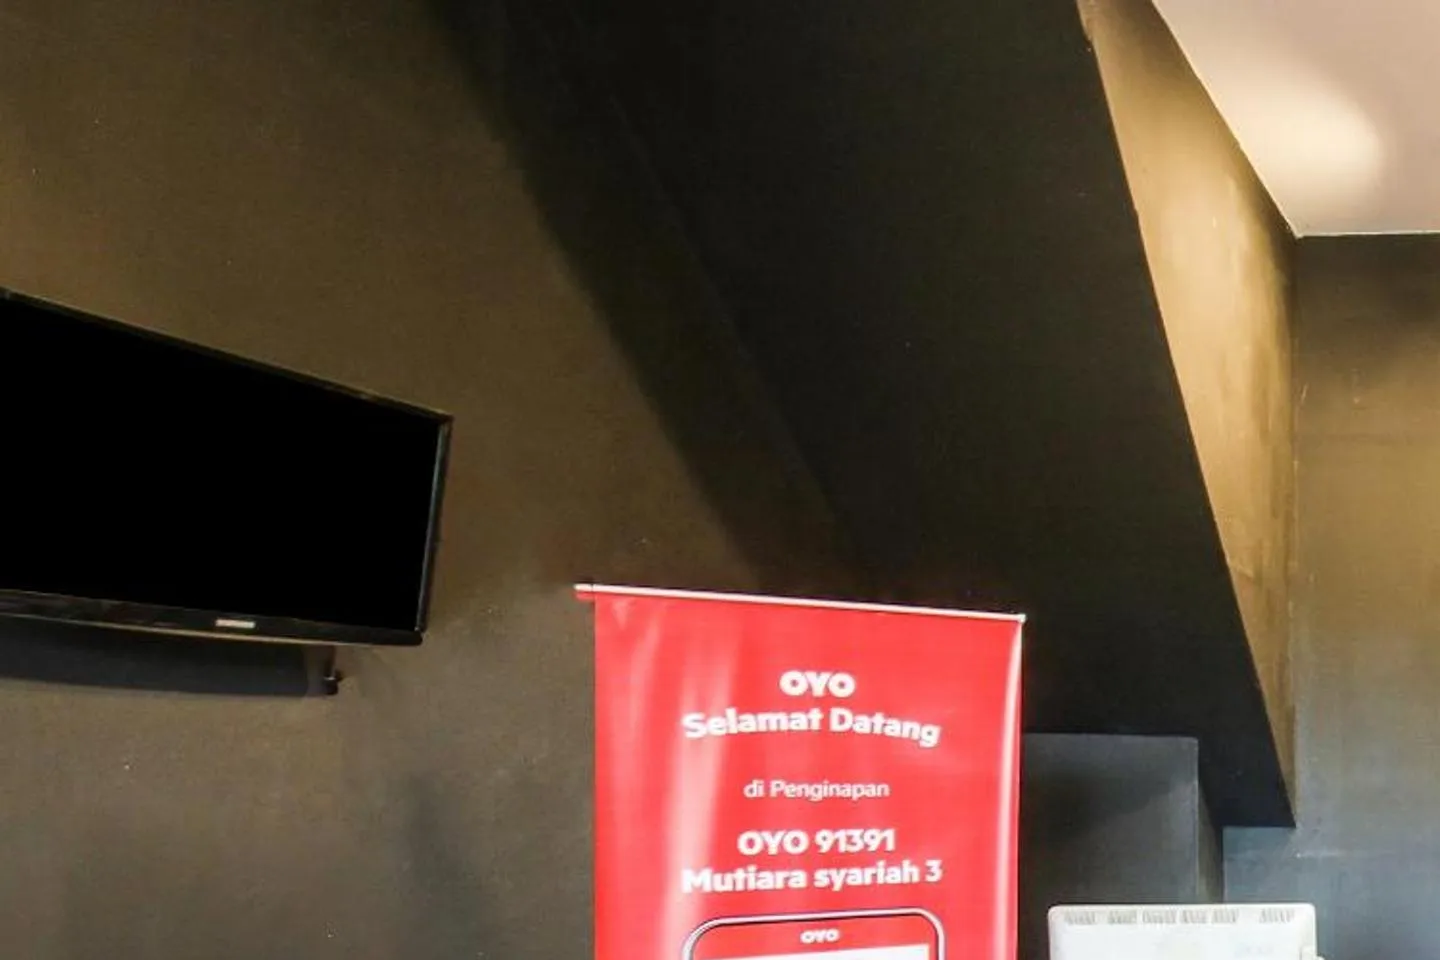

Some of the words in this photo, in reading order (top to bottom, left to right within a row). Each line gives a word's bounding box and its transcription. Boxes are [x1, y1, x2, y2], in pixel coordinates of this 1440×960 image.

[779, 671, 856, 698] OYO
[681, 707, 821, 739] Selamat
[830, 708, 941, 748] Datang
[743, 779, 764, 799] di
[770, 780, 890, 802] Penginapan
[737, 830, 809, 857] OYO
[815, 828, 895, 853] 91391
[681, 866, 807, 894] Mutiara
[814, 860, 920, 892] syariah
[924, 859, 942, 883] 3
[800, 928, 840, 944] OYO
